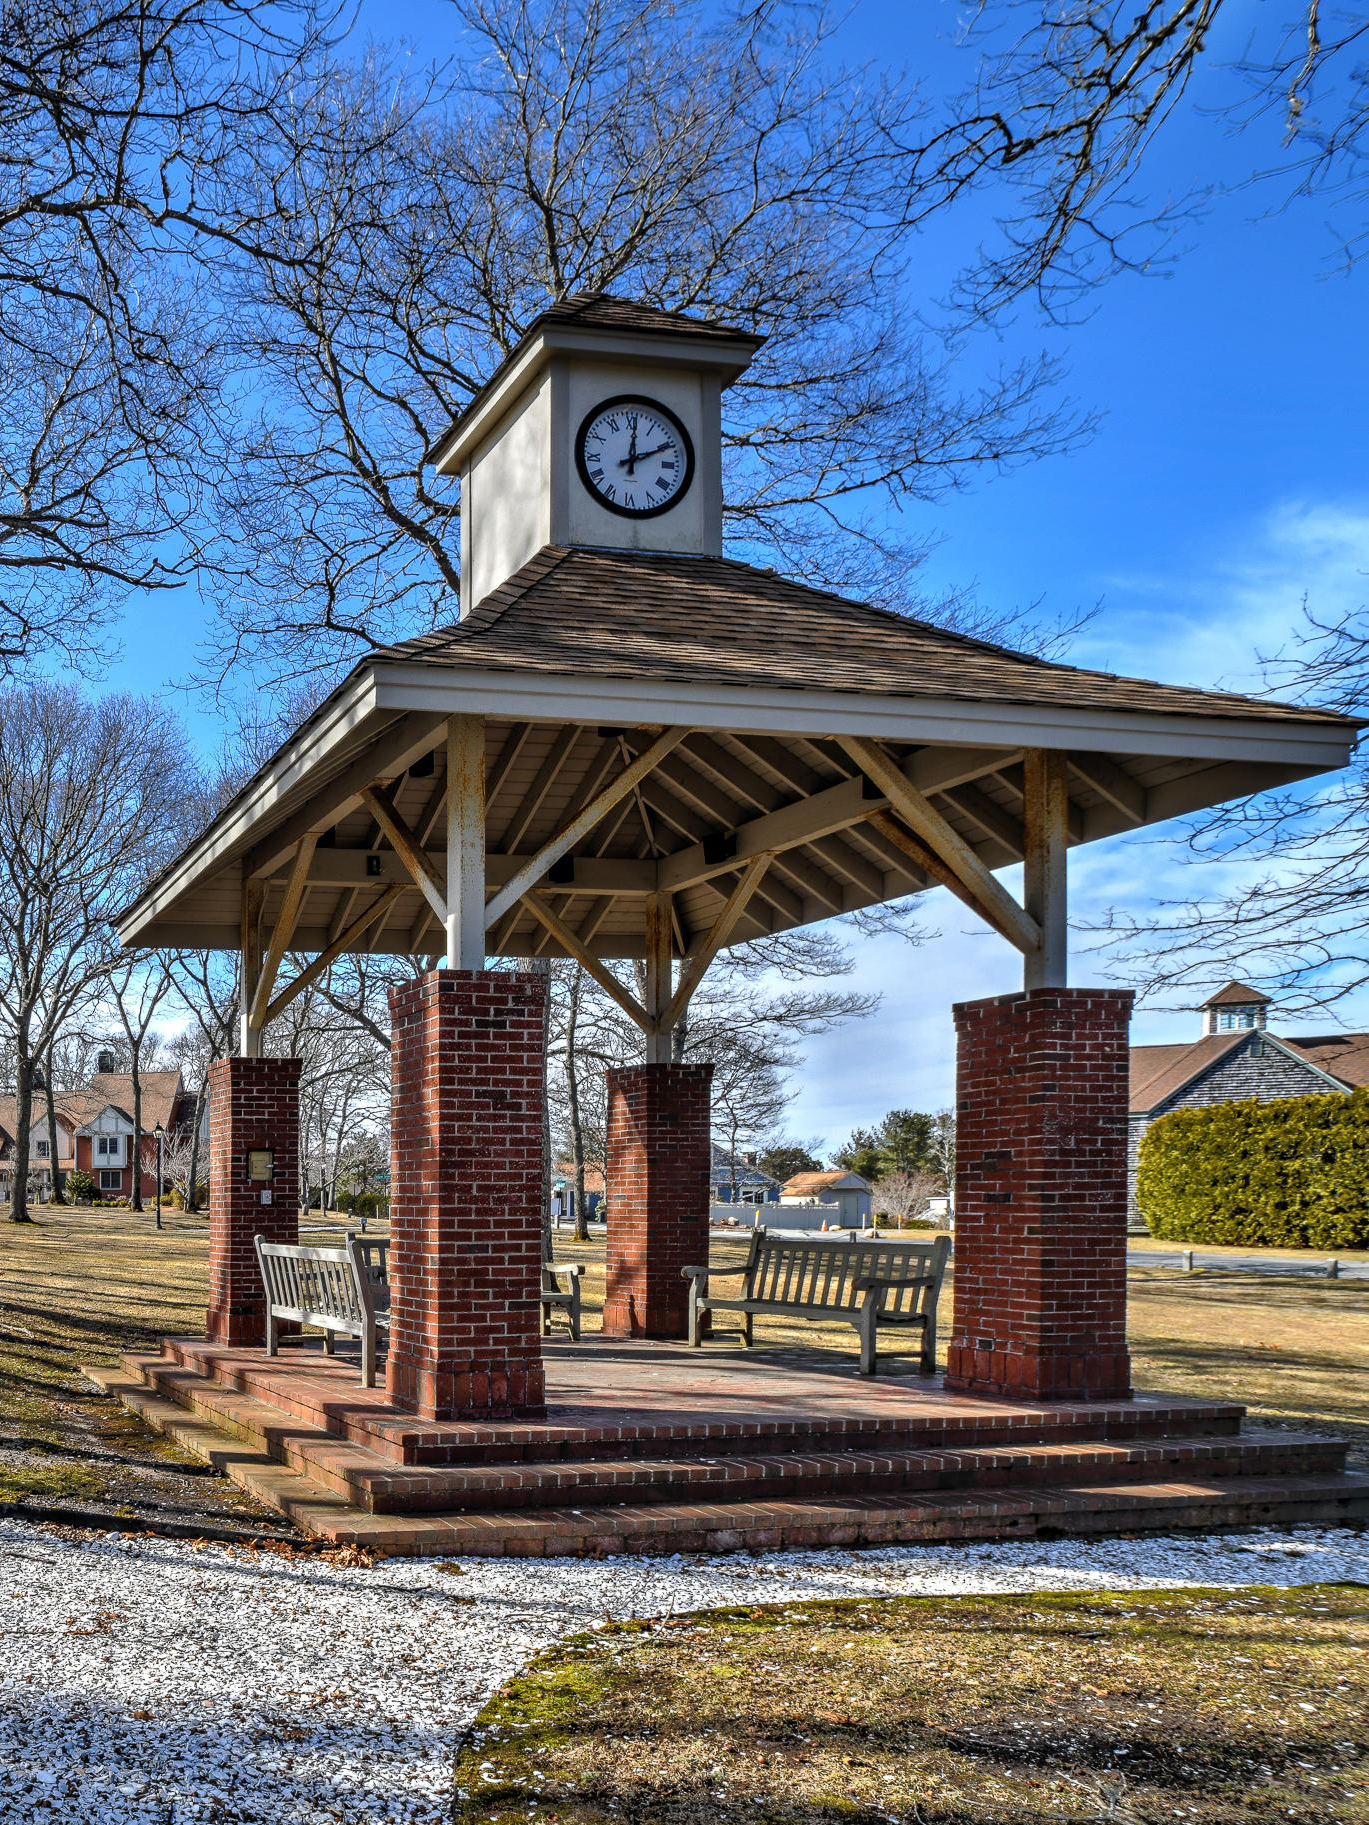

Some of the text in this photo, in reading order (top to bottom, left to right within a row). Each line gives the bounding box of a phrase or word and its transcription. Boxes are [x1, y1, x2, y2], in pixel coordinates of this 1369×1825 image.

[606, 418, 620, 434] XI
[646, 423, 655, 436] I
[591, 432, 606, 445] X
[587, 452, 601, 463] IX
[625, 492, 635, 507] VI
[646, 490, 655, 504] V
